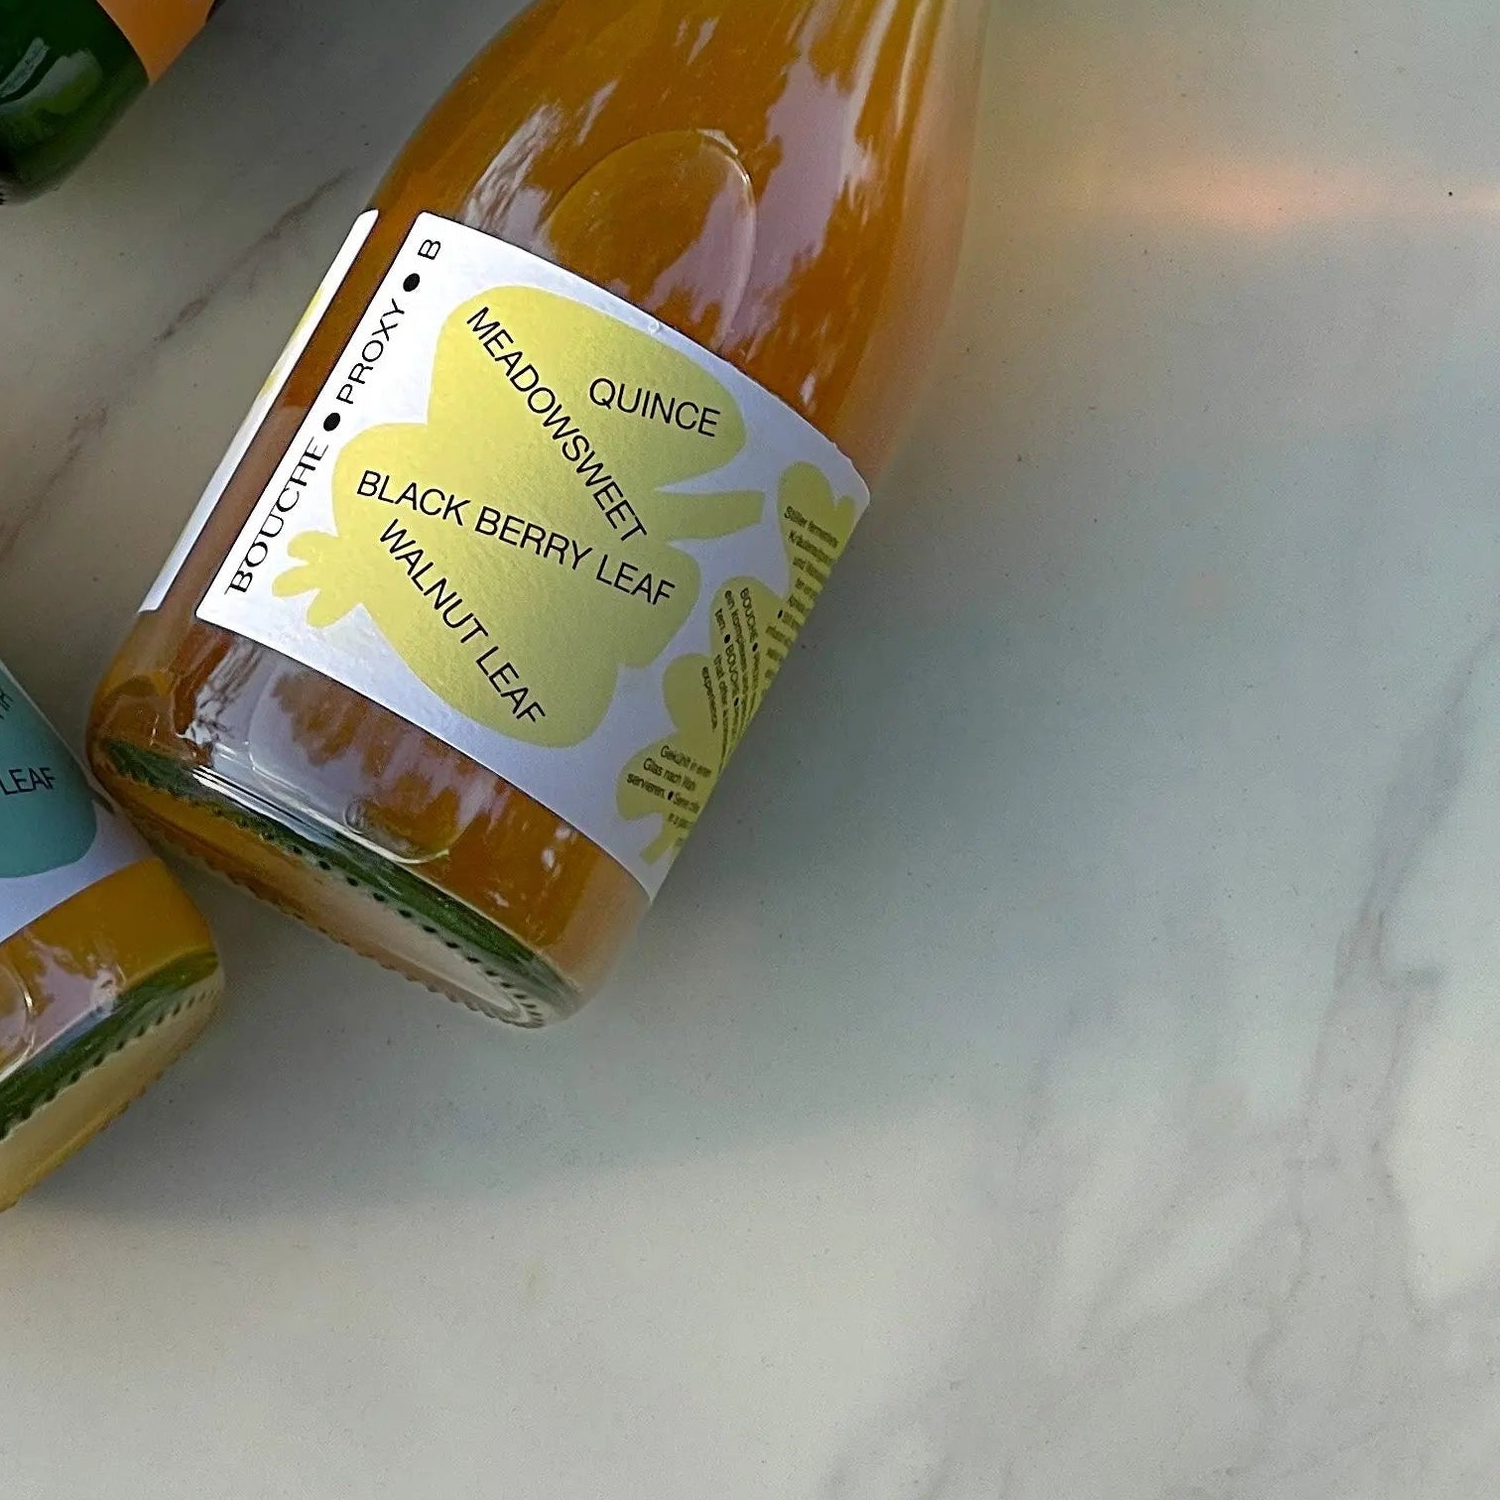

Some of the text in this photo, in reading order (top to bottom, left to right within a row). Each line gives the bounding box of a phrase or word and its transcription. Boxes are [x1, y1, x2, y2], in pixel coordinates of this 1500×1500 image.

[225, 239, 441, 594] BOUCHE PROXY B
[467, 307, 647, 542] MEADOWSWEET
[590, 378, 720, 437] QUINCE
[357, 470, 675, 606] BLACK BERRY LEAF
[380, 519, 545, 722] WALNUT LEAF
